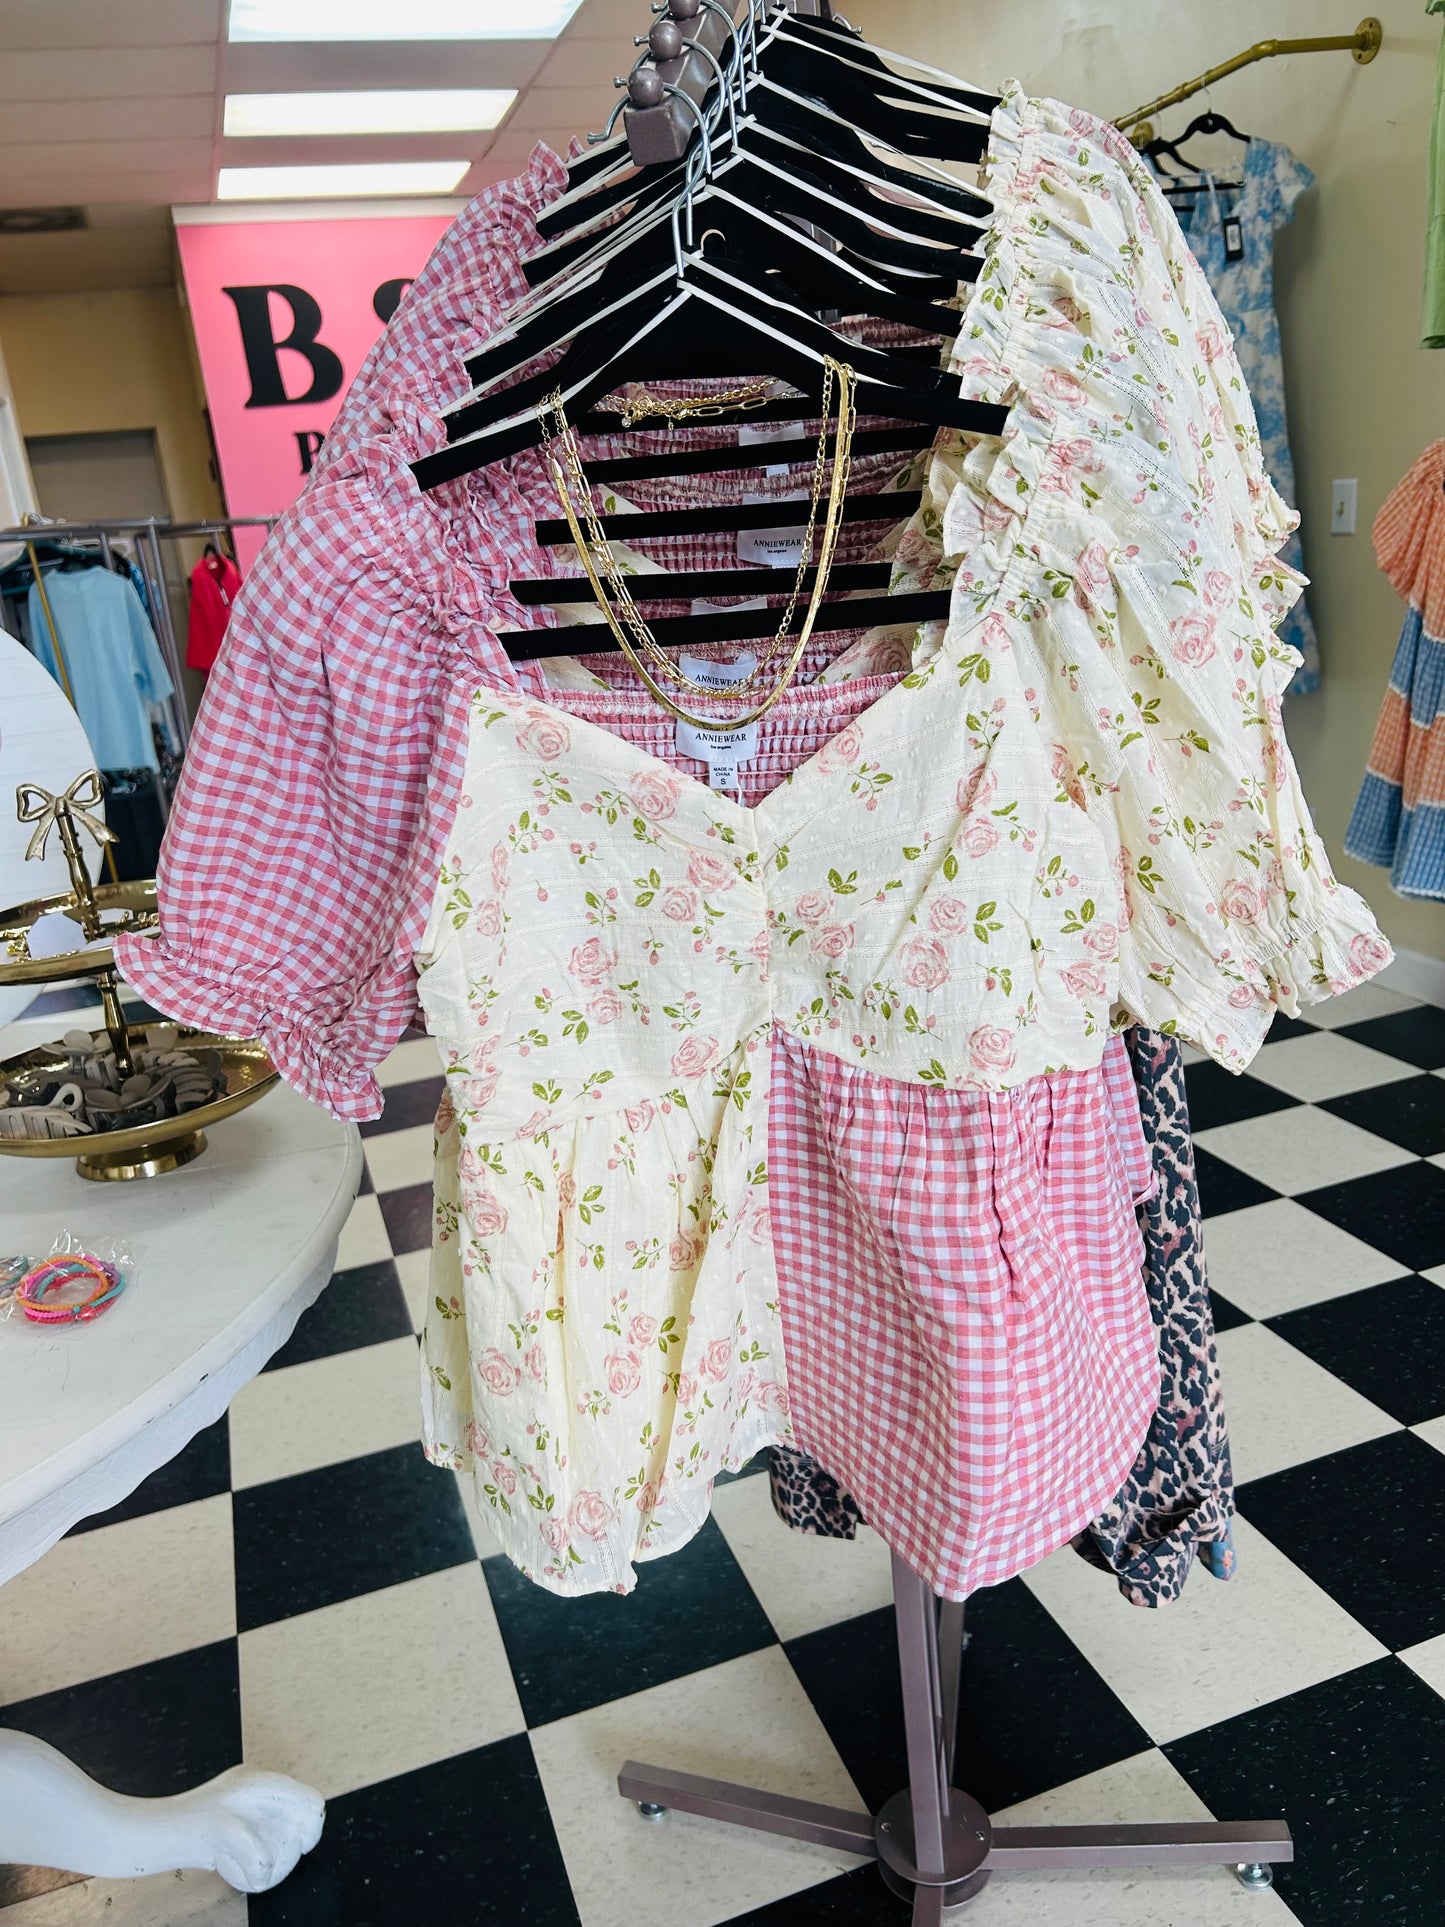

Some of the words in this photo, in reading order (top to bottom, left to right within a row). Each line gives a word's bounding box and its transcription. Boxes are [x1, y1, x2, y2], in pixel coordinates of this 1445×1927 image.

[753, 538, 802, 548] ANNIEWEAR
[695, 732, 747, 743] ANNIEWEAR
[720, 777, 727, 785] S
